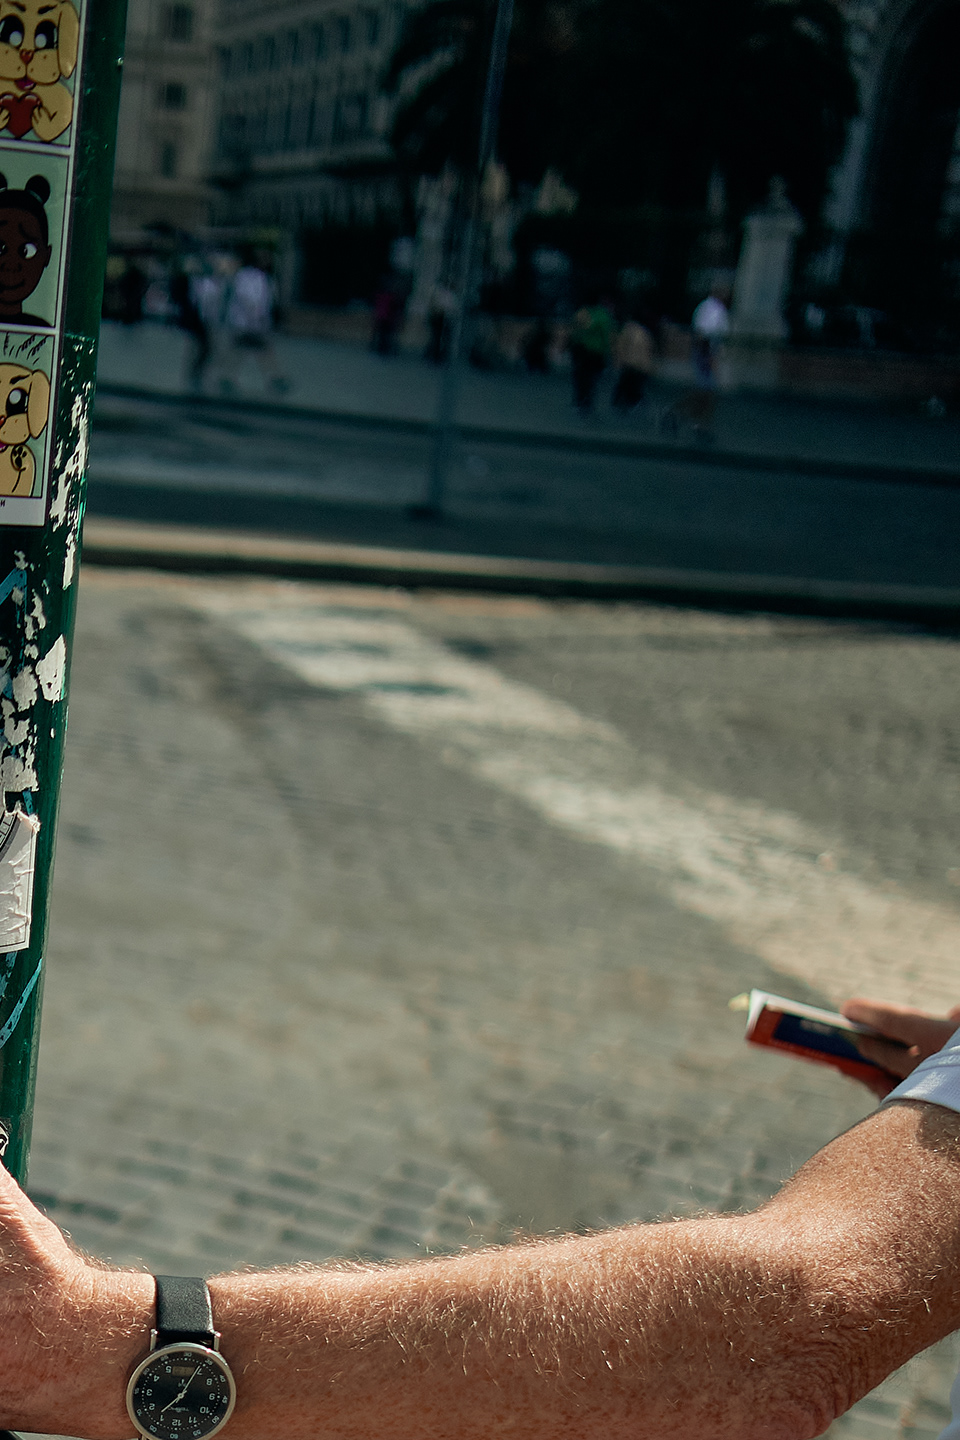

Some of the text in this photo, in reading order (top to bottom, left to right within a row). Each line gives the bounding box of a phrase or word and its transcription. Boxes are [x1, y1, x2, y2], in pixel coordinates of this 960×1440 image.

[146, 1388, 153, 1396] 3
[208, 1393, 215, 1401] 9
[200, 1406, 210, 1414] 10
[171, 1418, 182, 1426] 12
[188, 1416, 198, 1424] 11
